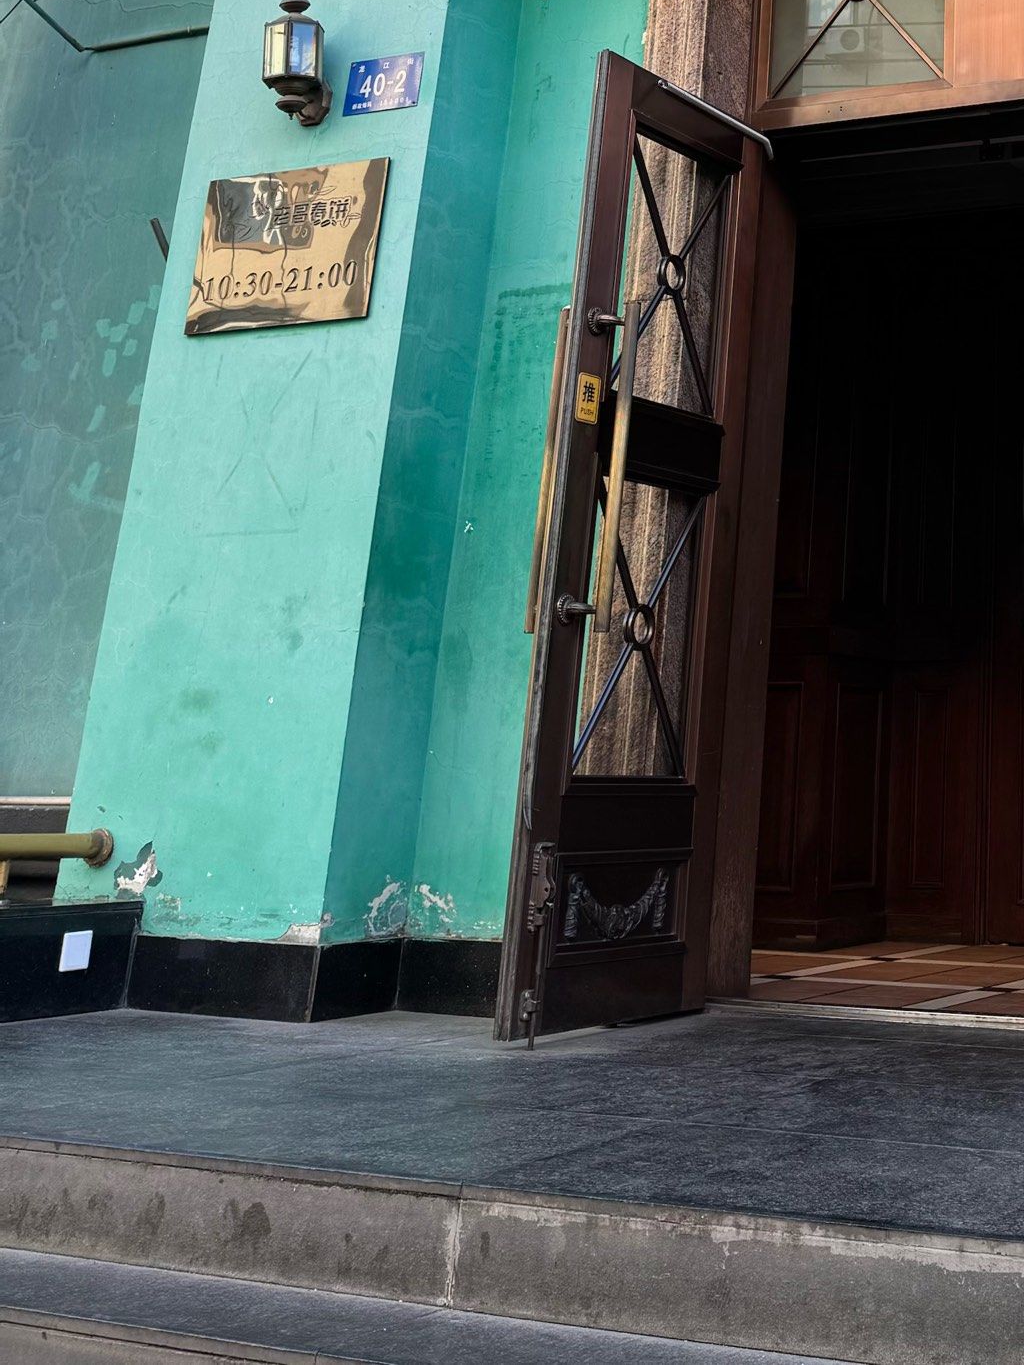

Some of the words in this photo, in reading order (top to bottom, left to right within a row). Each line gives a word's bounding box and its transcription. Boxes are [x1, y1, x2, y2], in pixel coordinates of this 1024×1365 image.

[359, 69, 407, 98] 40-2
[273, 198, 350, 226] 老昌春饼
[203, 260, 358, 302] 10:30-21:00
[582, 380, 596, 404] 推
